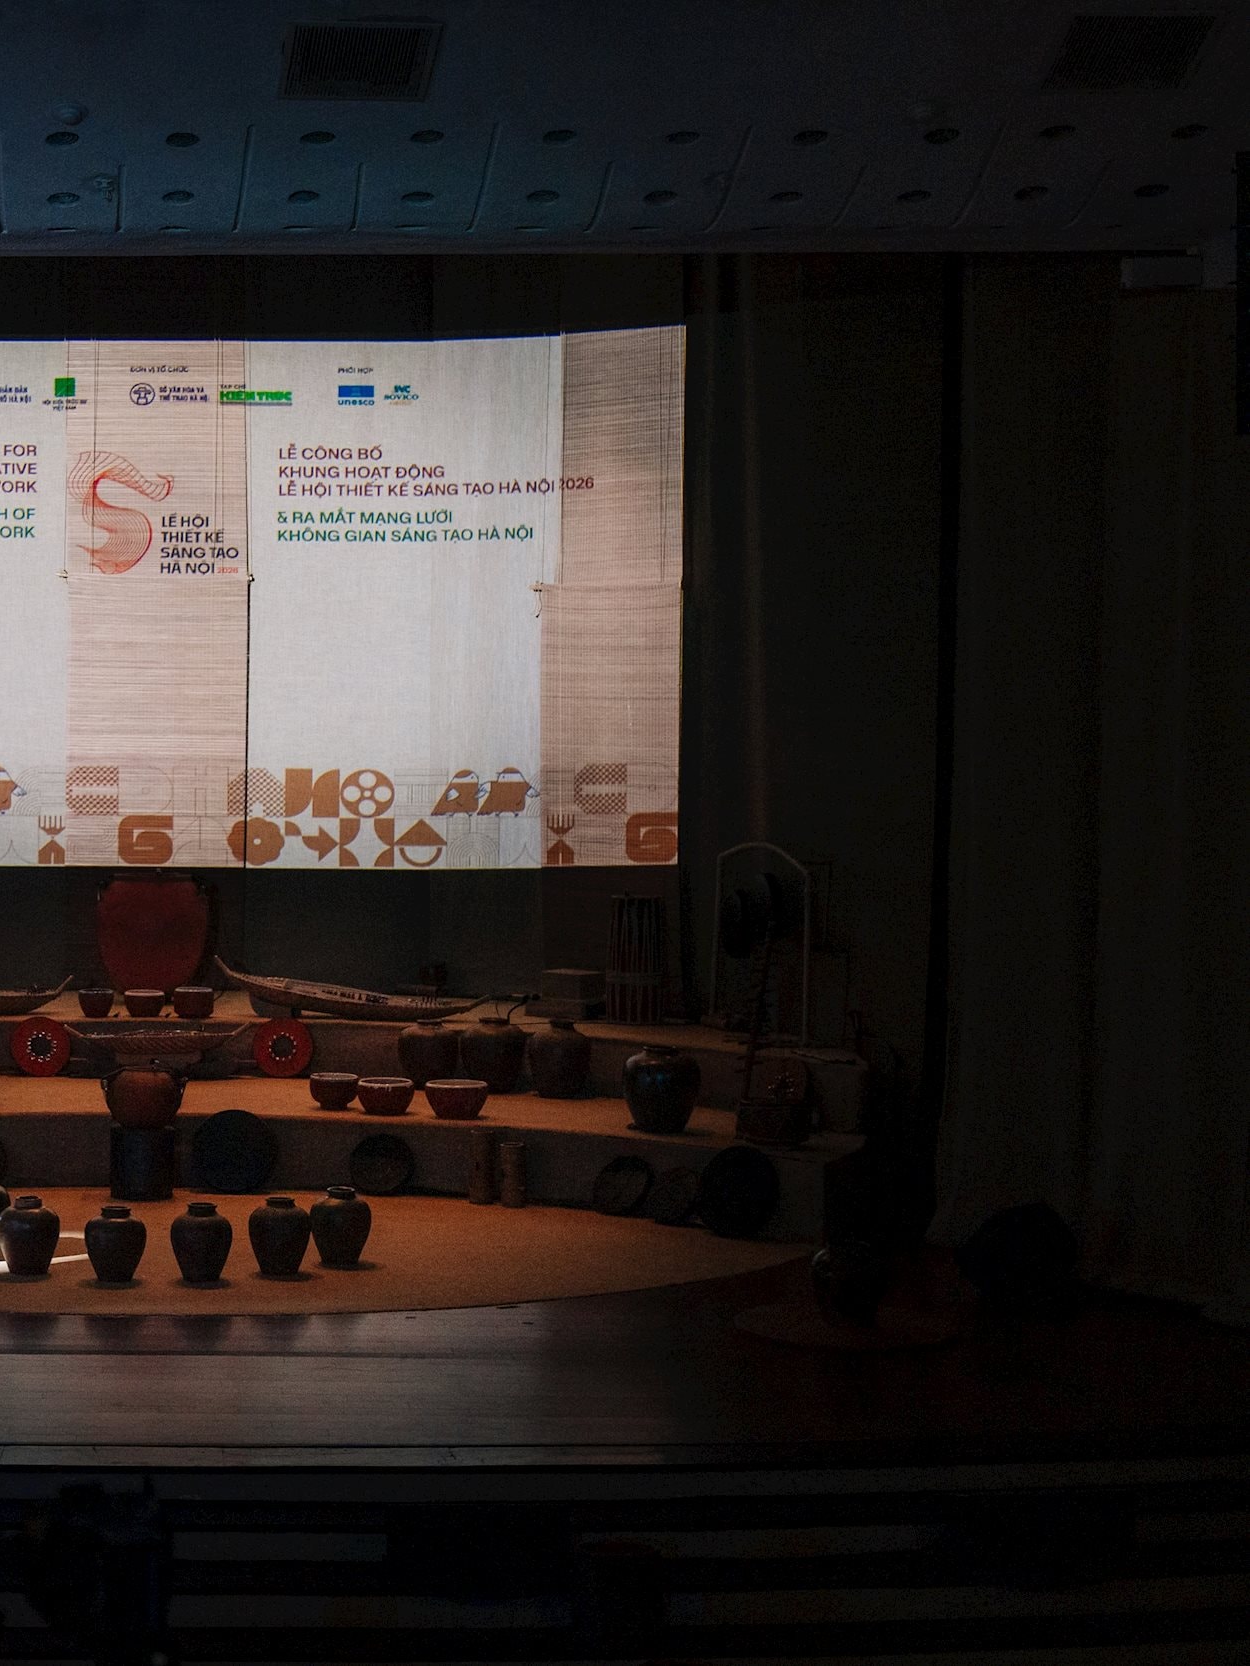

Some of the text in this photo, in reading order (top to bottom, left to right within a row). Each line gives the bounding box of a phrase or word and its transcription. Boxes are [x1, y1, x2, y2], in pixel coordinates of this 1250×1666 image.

[3, 444, 37, 457] FOR
[279, 443, 382, 460] LỄ CÔNG BỐ
[279, 464, 445, 480] KHUNG HOẠT ĐỘNG
[279, 477, 594, 498] LỄ HỘI THIẾT KẾ SÁNG TẠO HÀ NỘI 2026
[12, 508, 36, 520] OF
[181, 514, 209, 528] HỘI
[277, 512, 288, 524] &
[292, 512, 315, 524] RA
[320, 507, 356, 524] MẮT
[360, 512, 411, 526] MẠNG
[161, 529, 201, 543] THIẾT
[277, 525, 534, 543] KHÔNG GIAN SÁNG TẠO HÀ NỘI
[161, 544, 206, 558] SÁNG
[185, 560, 215, 575] NỘI
